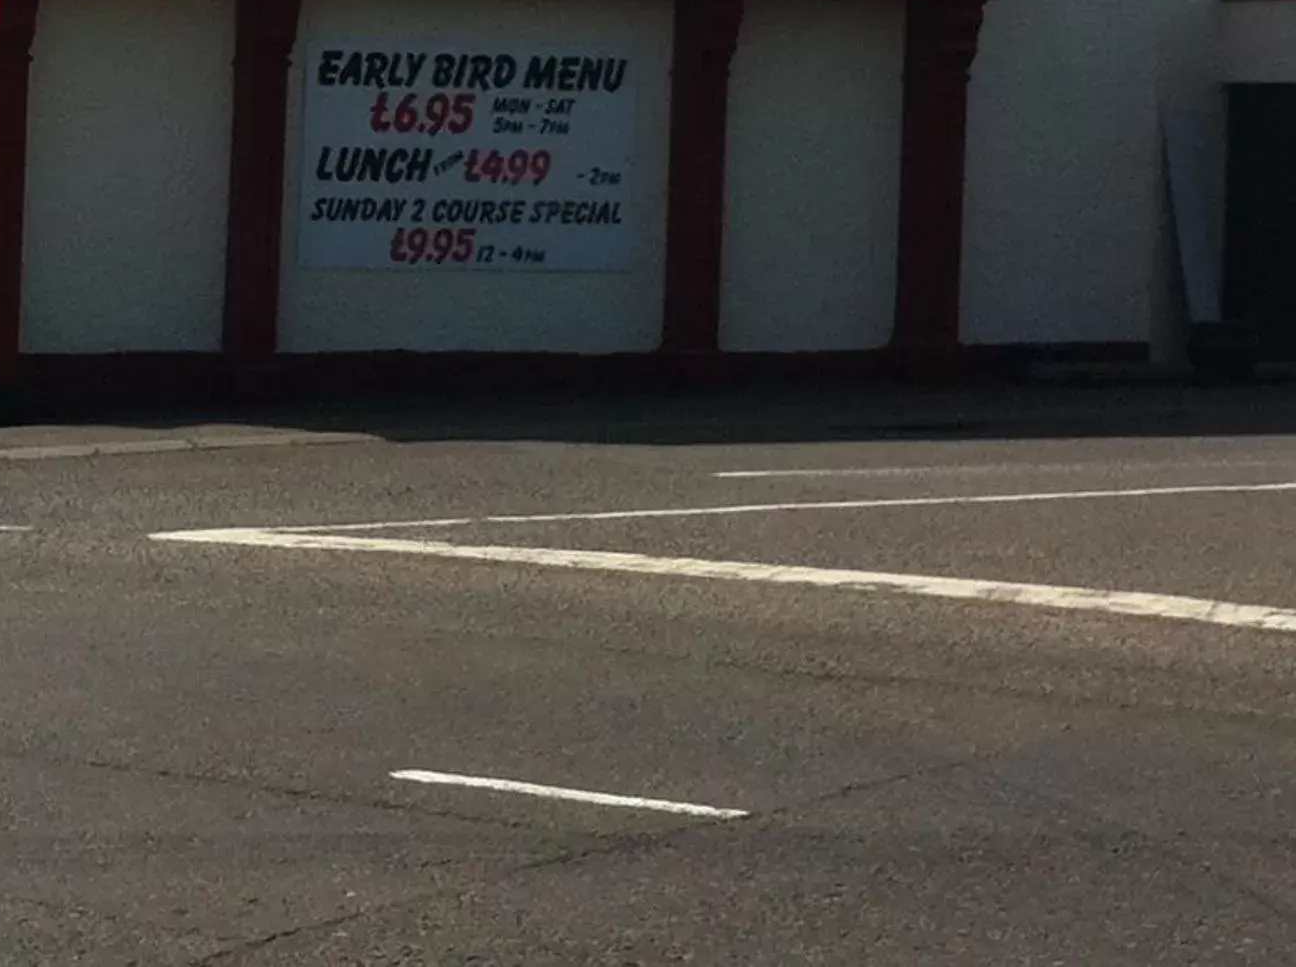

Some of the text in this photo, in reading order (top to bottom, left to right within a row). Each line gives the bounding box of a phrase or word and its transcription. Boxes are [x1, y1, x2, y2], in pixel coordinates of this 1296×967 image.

[317, 50, 628, 93] EARLY BIRD MENU
[369, 92, 477, 137] £6.95
[545, 98, 576, 115] SAT
[315, 146, 434, 184] LUNCH
[310, 197, 624, 227] SUNDAY 2 COURSE SPECIAL
[389, 226, 478, 266] £9.95
